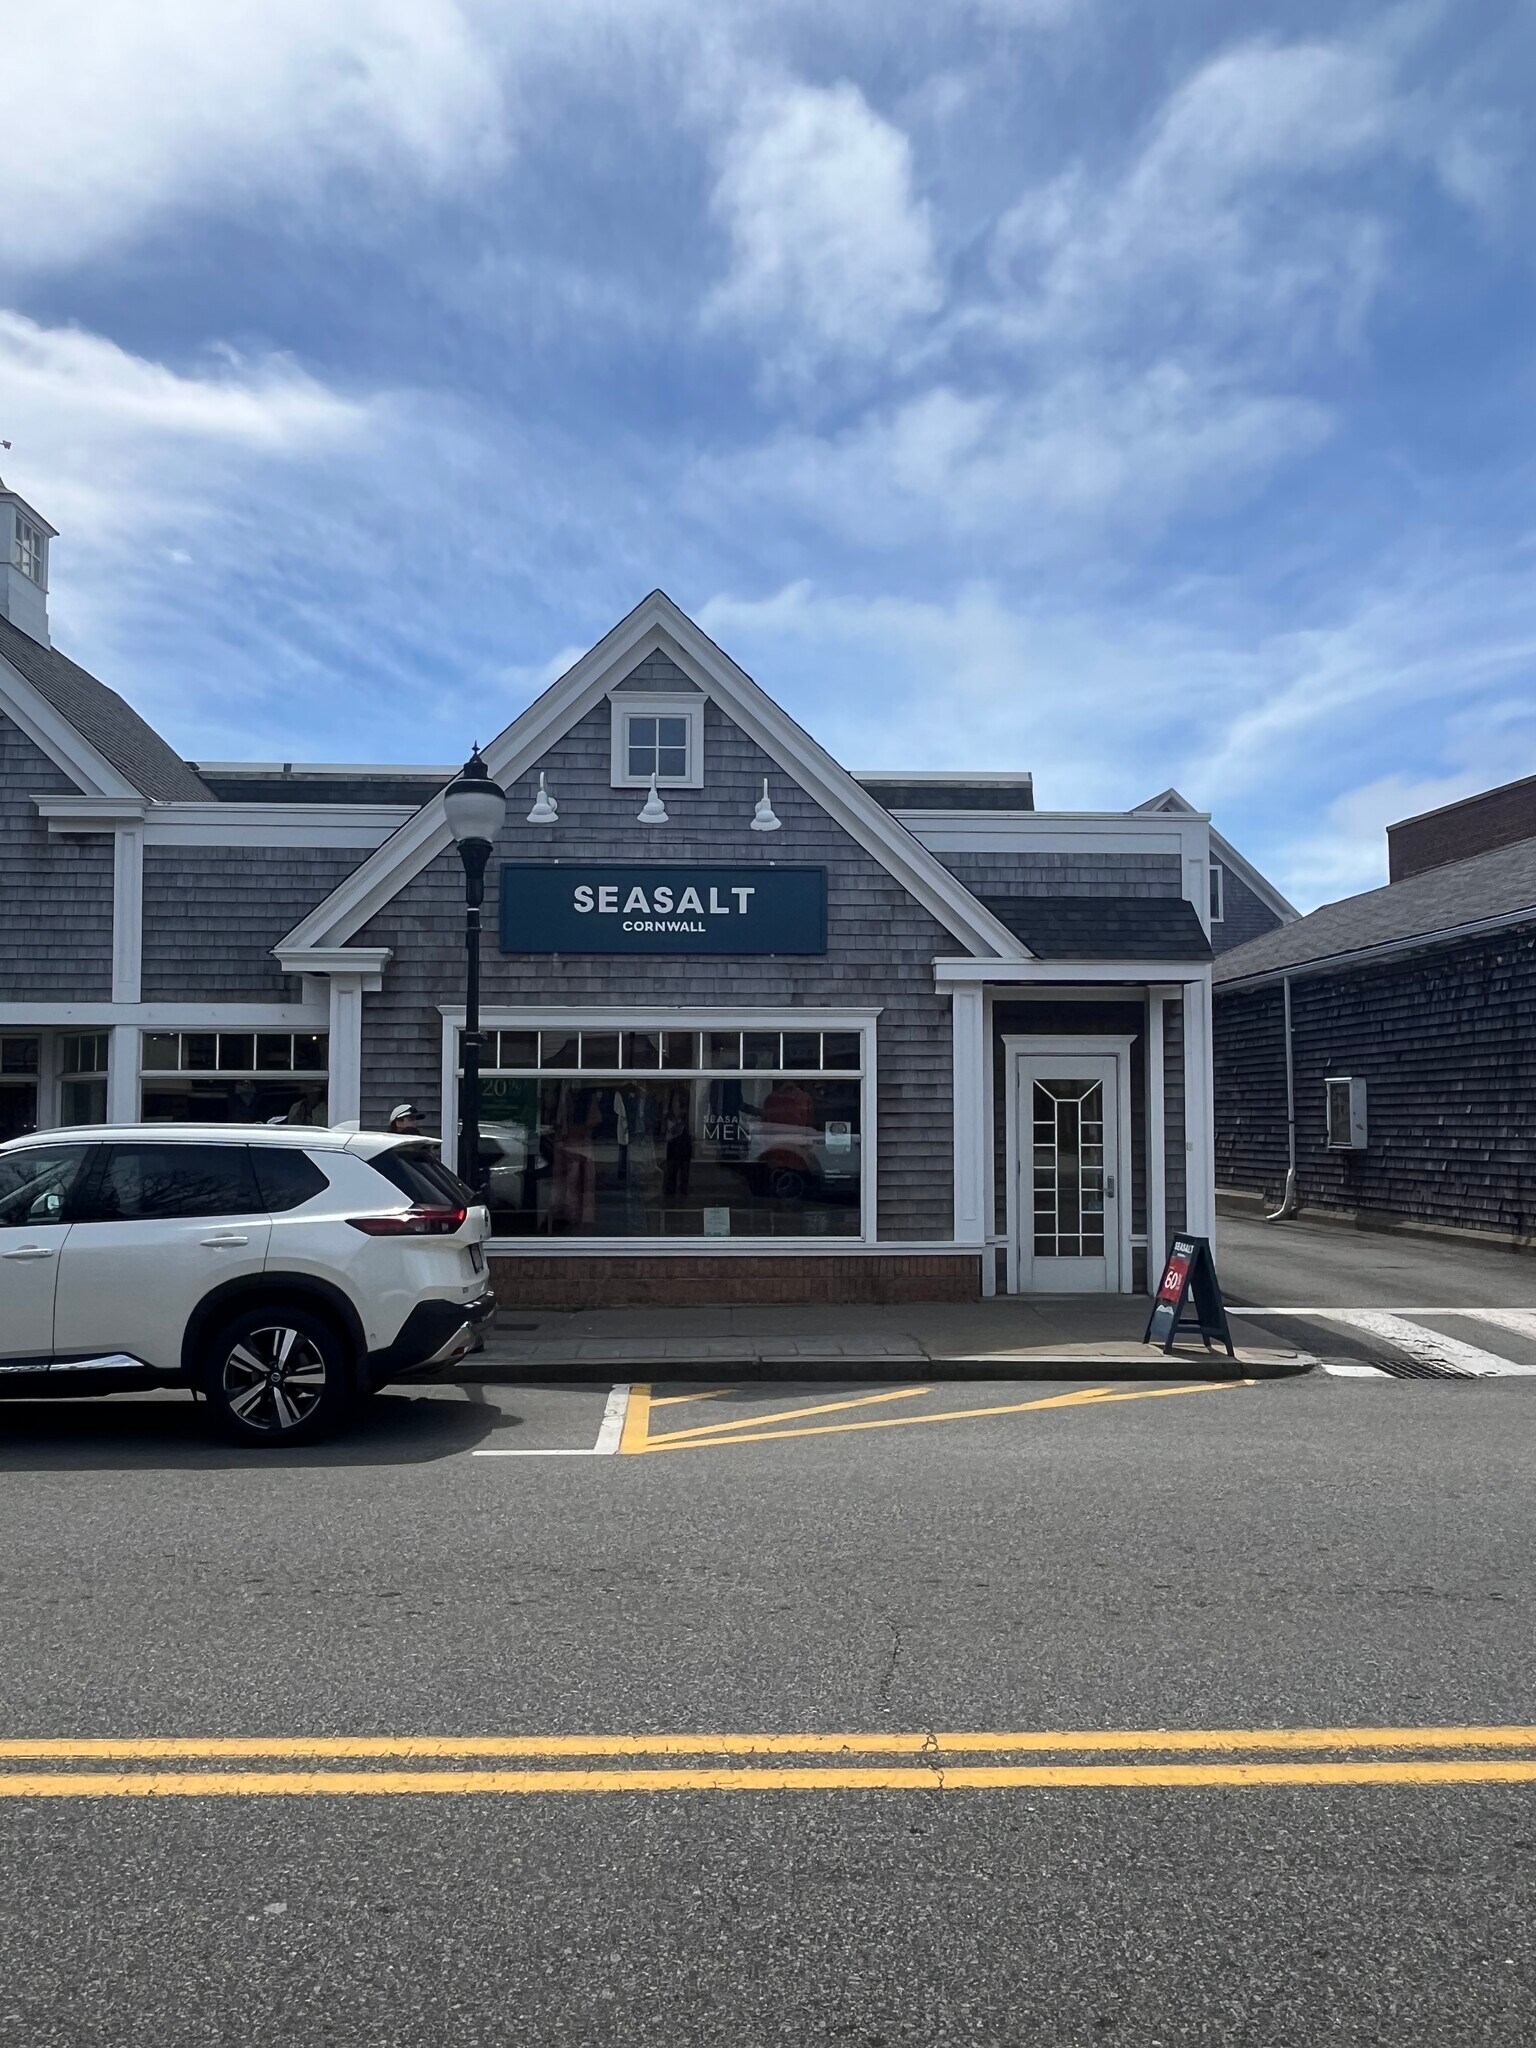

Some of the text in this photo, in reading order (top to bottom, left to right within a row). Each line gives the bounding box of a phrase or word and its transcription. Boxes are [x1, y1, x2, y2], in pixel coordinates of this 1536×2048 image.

[573, 885, 755, 914] SEASALT
[622, 921, 706, 932] CORNWALL
[703, 1123, 751, 1140] MEN
